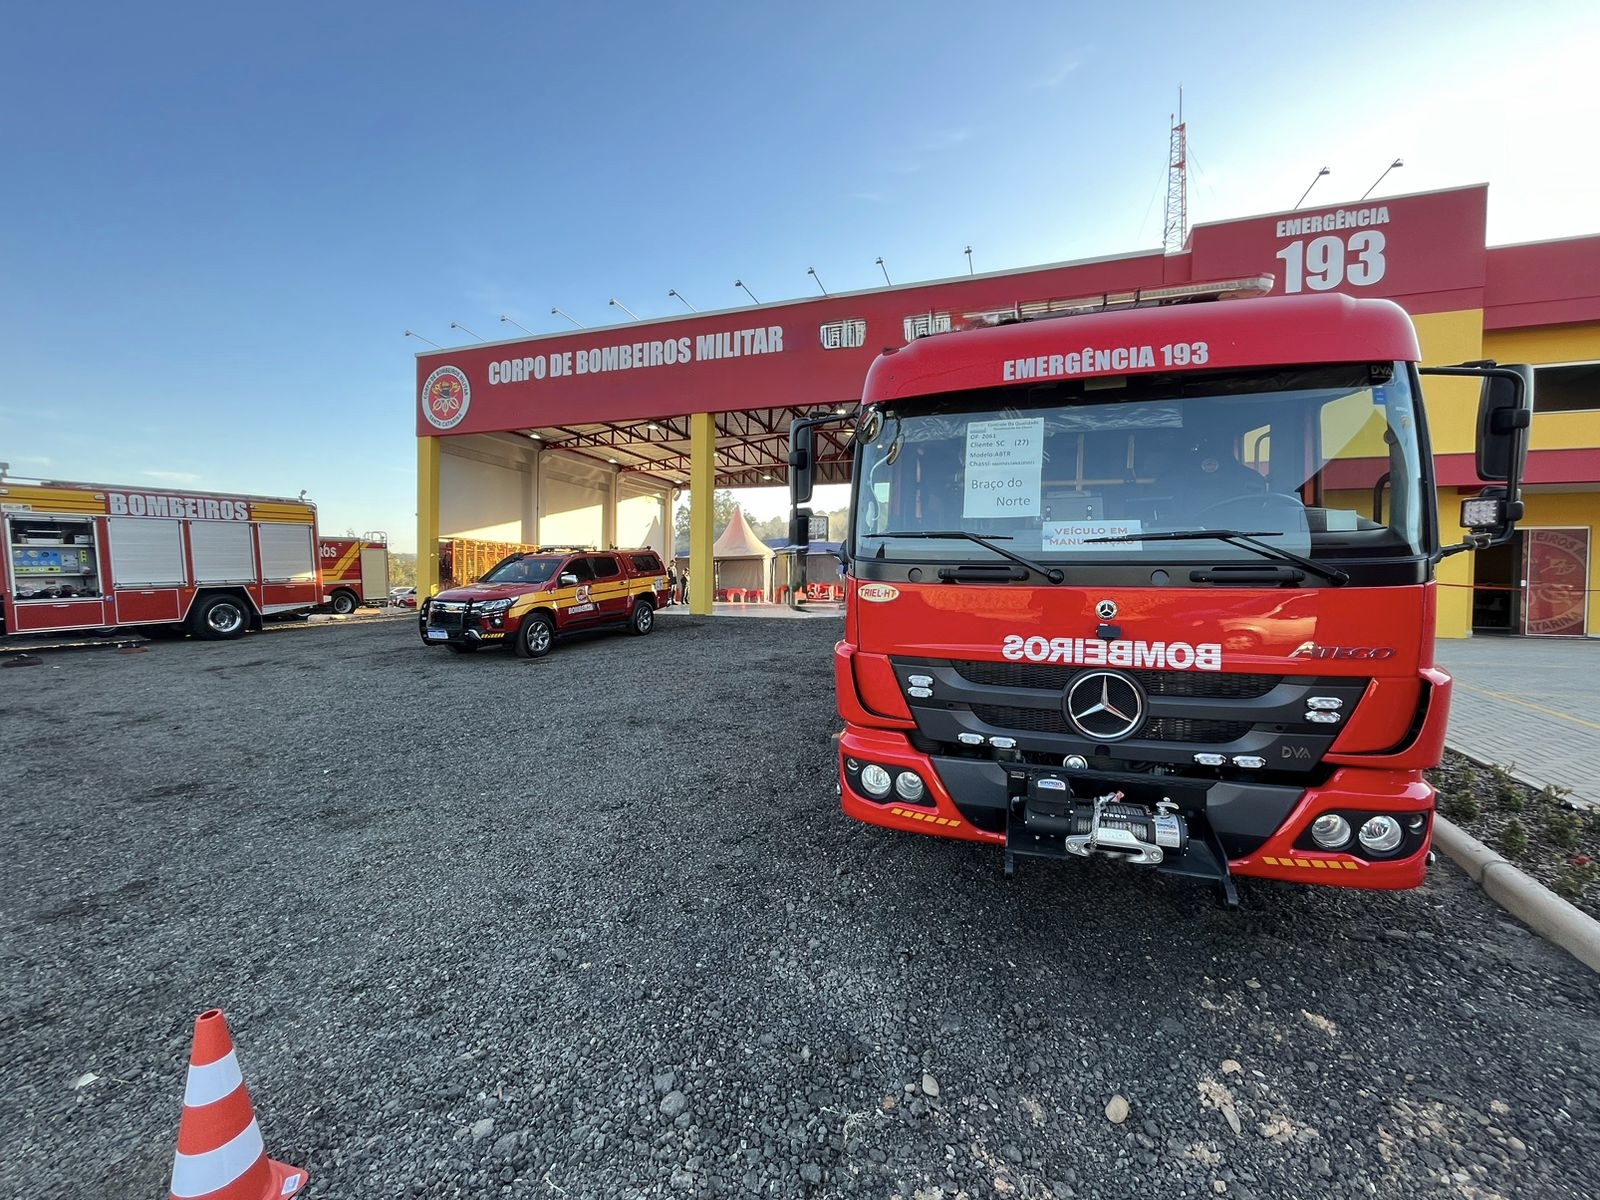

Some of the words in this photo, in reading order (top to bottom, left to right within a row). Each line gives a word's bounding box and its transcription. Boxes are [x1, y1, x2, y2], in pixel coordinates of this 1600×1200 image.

[1276, 206, 1390, 238] EMERGÊNCIA
[1276, 230, 1386, 294] 193
[488, 356, 546, 385] CORPO
[550, 352, 573, 378] DE
[576, 337, 691, 375] BOMBEIROS
[696, 325, 784, 361] MILITAR
[1003, 346, 1156, 382] EMERGÊNCIA
[1160, 341, 1209, 367] 193
[1014, 439, 1029, 447] (27)
[971, 480, 1004, 490] Braço
[1007, 478, 1022, 488] do
[109, 494, 249, 521] BOMBEIROS
[996, 497, 1031, 506] Norte
[1055, 527, 1106, 535] VEÍCULO
[1281, 746, 1311, 759] DVA
